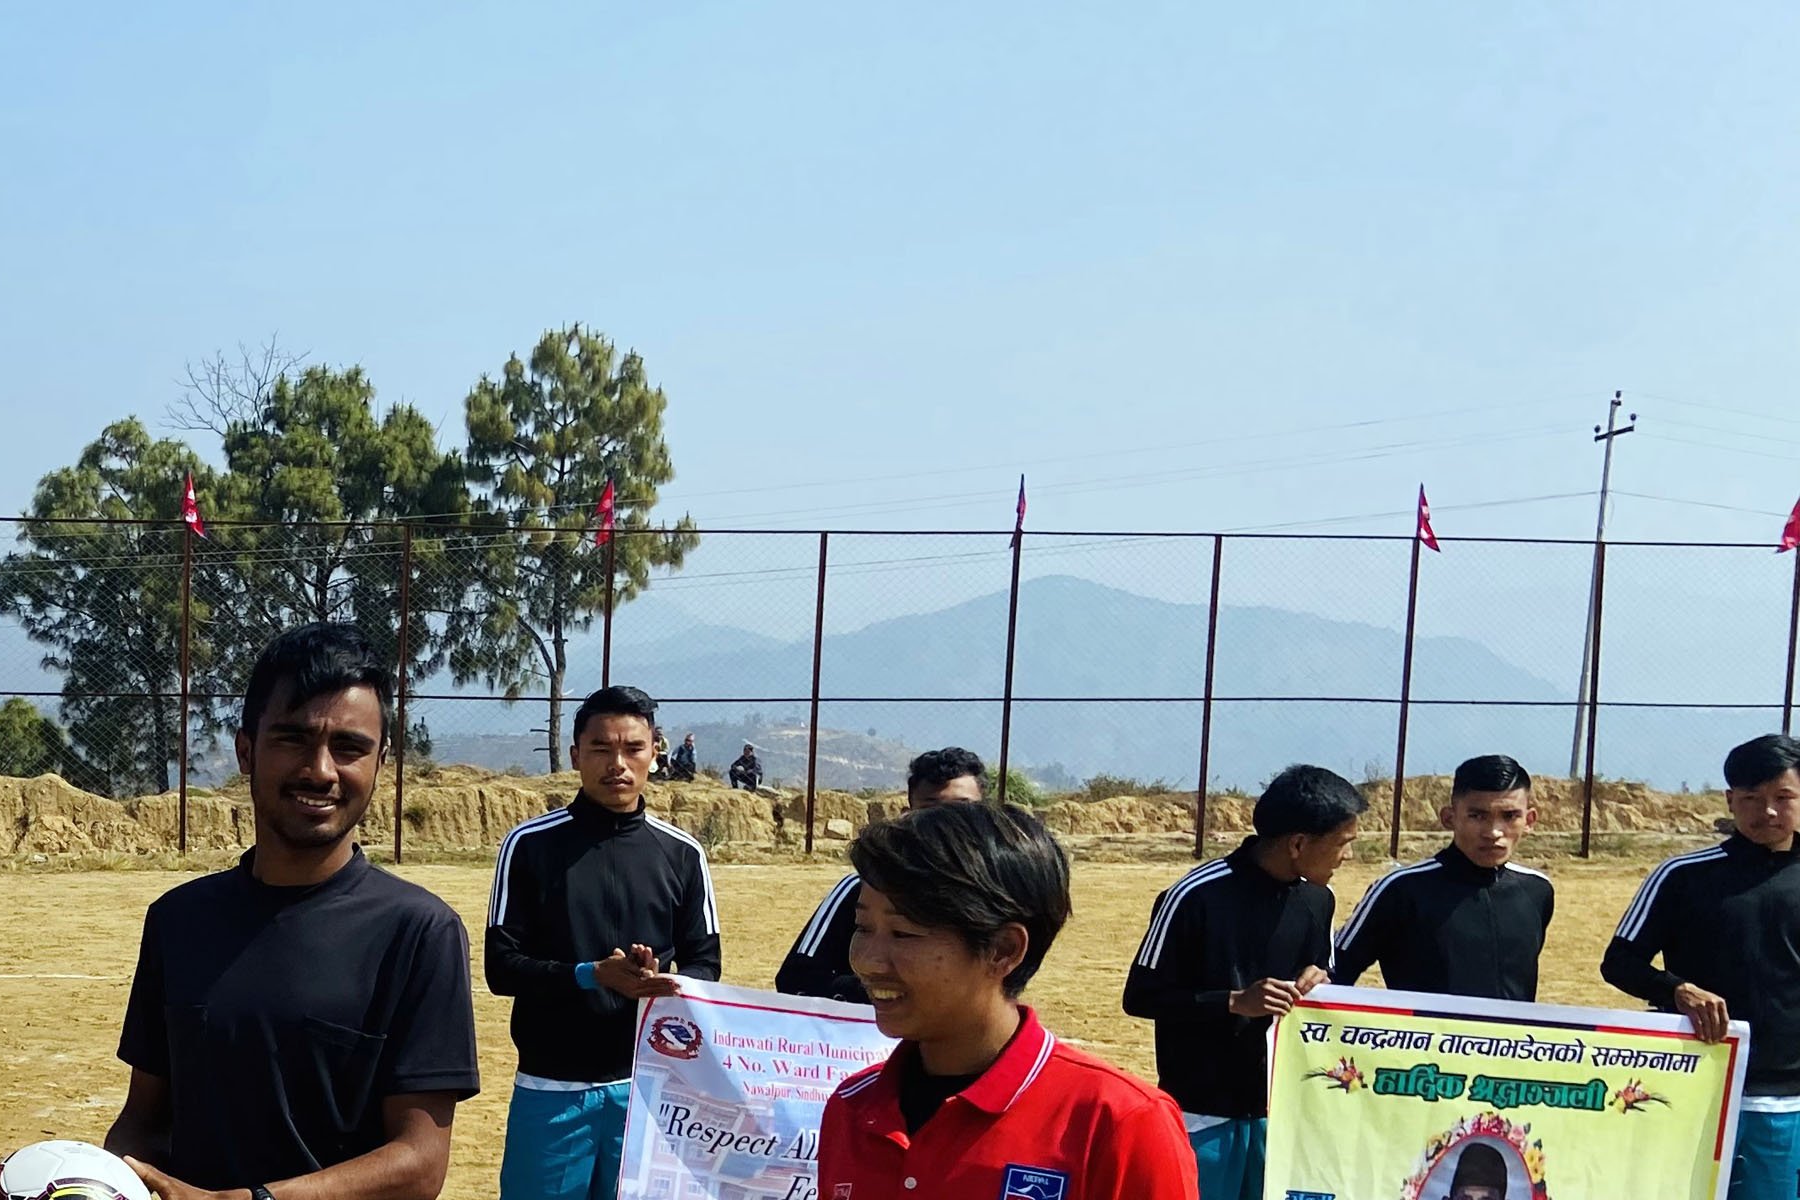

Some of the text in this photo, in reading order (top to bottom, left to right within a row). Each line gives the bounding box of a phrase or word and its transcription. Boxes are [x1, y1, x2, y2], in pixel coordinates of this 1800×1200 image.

[713, 1029, 773, 1051] Indrawati
[778, 1038, 814, 1056] Rural
[1340, 1026, 1434, 1051] चन्द्रमान
[1591, 1046, 1701, 1073] सम्झनामा
[722, 1055, 732, 1069] 4
[738, 1056, 766, 1073] No.
[772, 1060, 819, 1079] Ward
[1373, 1063, 1467, 1102] हार्दिक
[781, 1132, 818, 1161] Al
